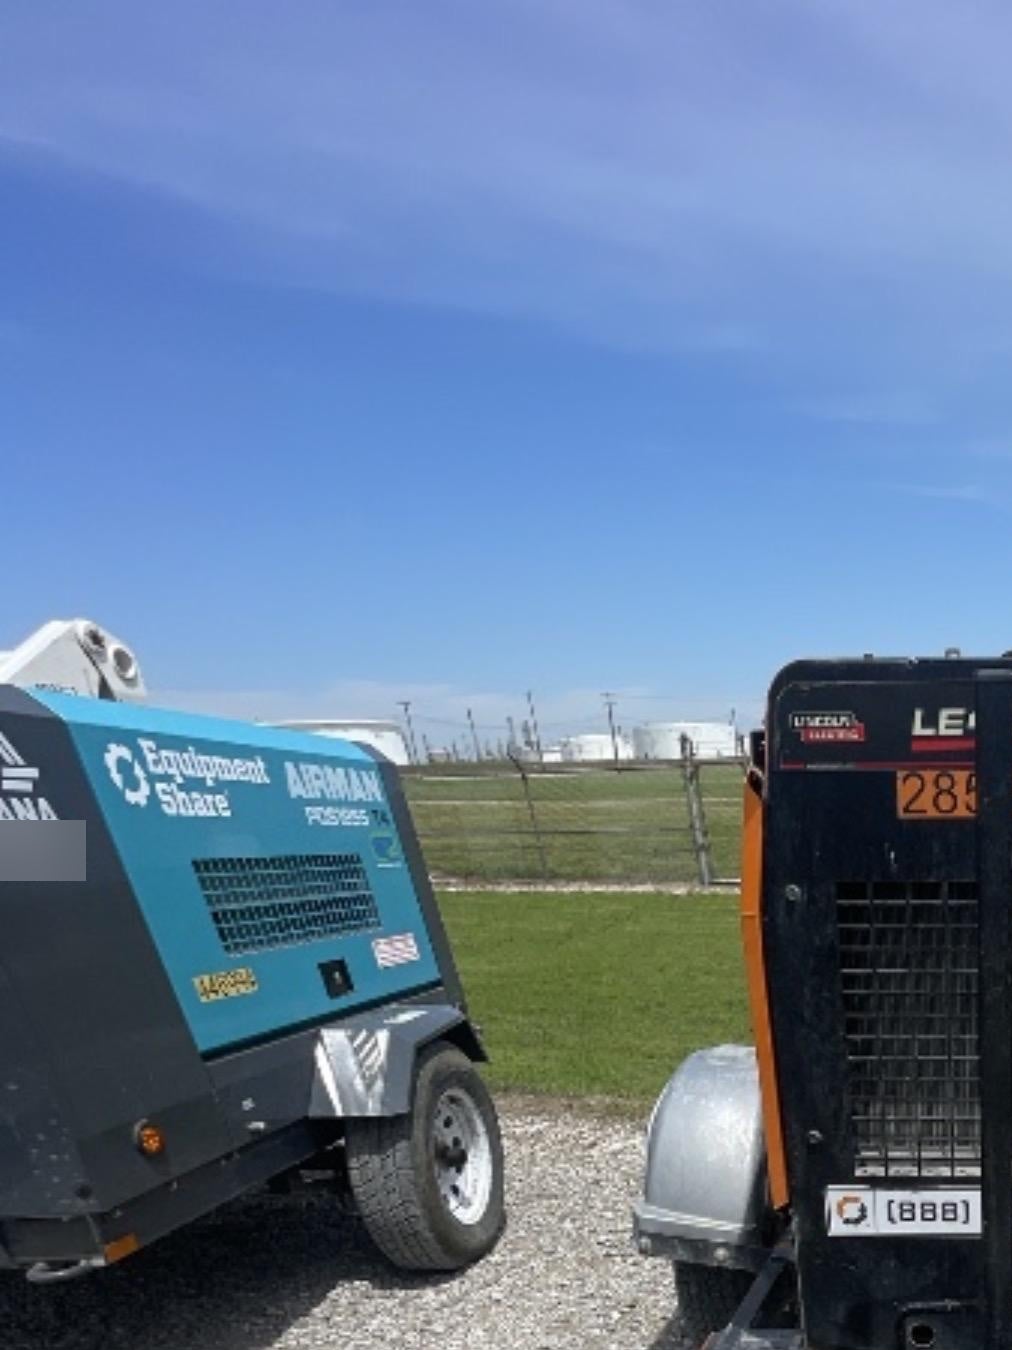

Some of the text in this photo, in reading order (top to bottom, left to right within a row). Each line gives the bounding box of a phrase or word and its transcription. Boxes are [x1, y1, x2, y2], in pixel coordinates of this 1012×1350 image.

[137, 738, 271, 786] Equipment
[284, 761, 385, 802] AIRMAN
[155, 782, 232, 816] Share
